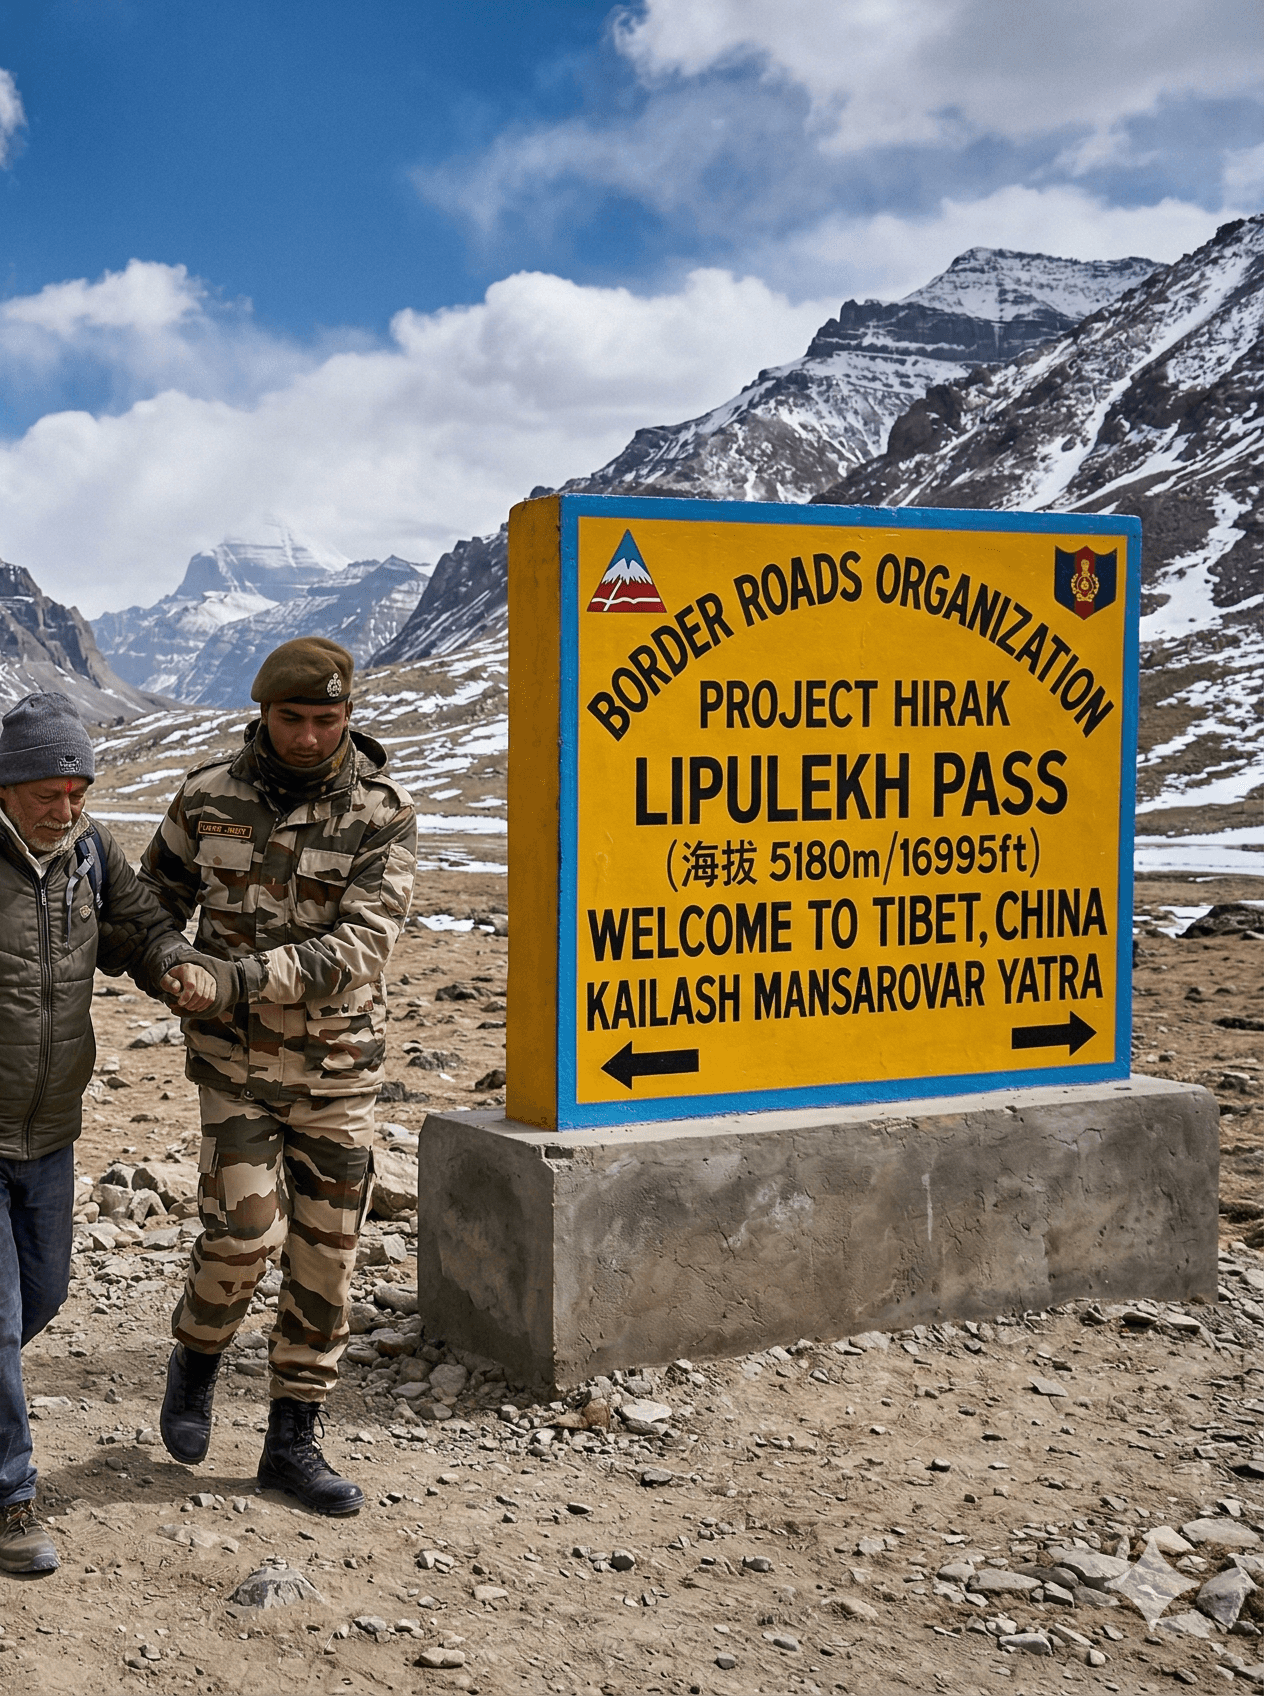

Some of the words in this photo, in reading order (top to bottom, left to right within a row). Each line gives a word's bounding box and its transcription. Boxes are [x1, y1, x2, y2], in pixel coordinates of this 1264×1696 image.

[587, 593, 735, 742] BORDER
[734, 551, 863, 628] ROADS
[875, 552, 1115, 739] ORGANIZATION
[700, 680, 879, 729] PROJECT
[894, 680, 1011, 727] HIRAK
[636, 752, 910, 826] LIPULEKH
[933, 749, 1068, 818] PASS
[667, 839, 758, 893] (海拔
[769, 827, 1040, 886] 5180m/16995ft)
[587, 902, 792, 962] WELCOME
[807, 897, 858, 951] TO
[586, 973, 740, 1032] KAILASH
[754, 961, 985, 1022] MANSAROVAR
[997, 953, 1104, 1005] YATRA
